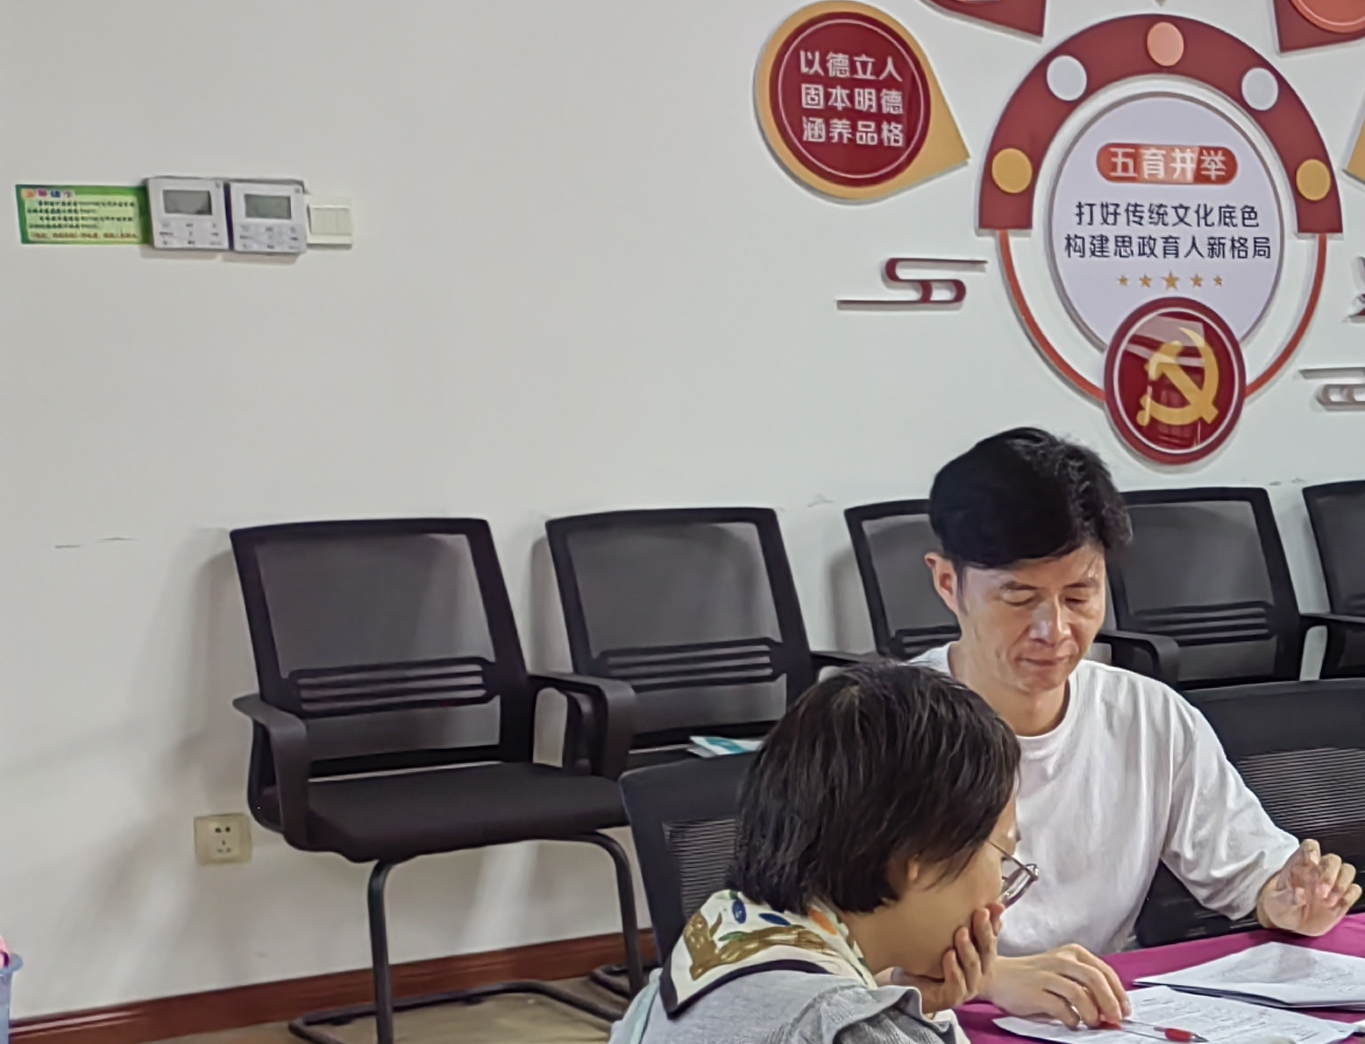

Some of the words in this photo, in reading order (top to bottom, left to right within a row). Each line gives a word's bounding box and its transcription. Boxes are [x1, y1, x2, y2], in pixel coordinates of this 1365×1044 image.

[799, 49, 903, 82] 以德立人
[801, 83, 904, 115] 固本明德
[802, 115, 905, 147] 涵养品格
[1109, 147, 1227, 181] 五育并举
[1075, 201, 1260, 228] 打好传统文化底色
[1064, 233, 1272, 260] 构建思政育人新格局
